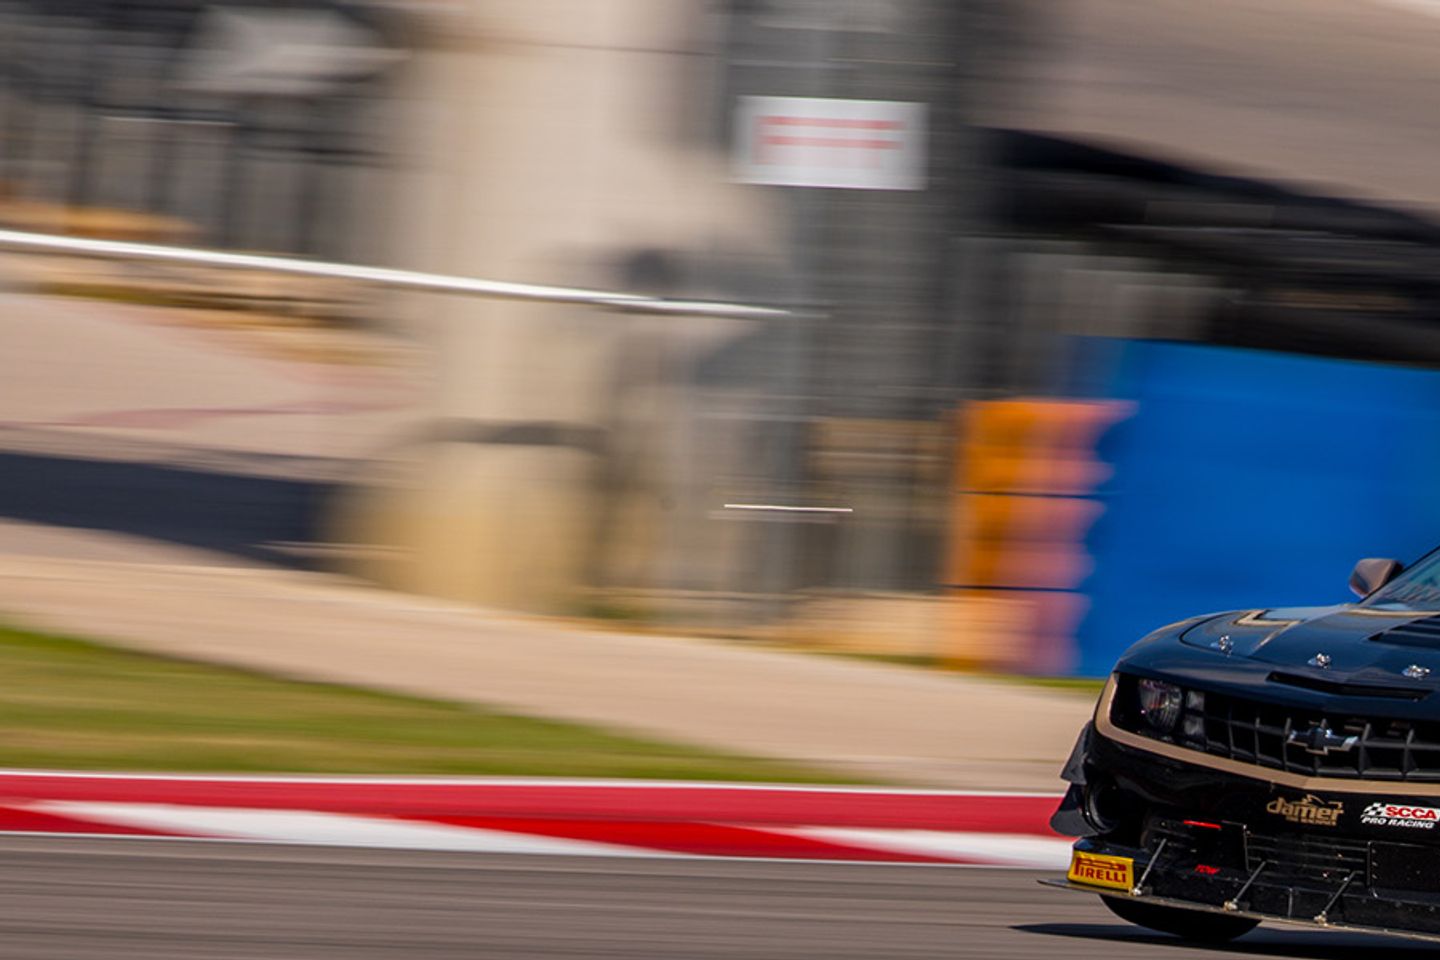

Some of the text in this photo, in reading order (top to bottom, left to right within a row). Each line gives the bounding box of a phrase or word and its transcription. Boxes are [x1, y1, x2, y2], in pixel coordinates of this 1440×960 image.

[1386, 806, 1437, 819] SCCA
[1361, 816, 1435, 829] PRO RACING
[1074, 857, 1127, 883] PIRELLI
